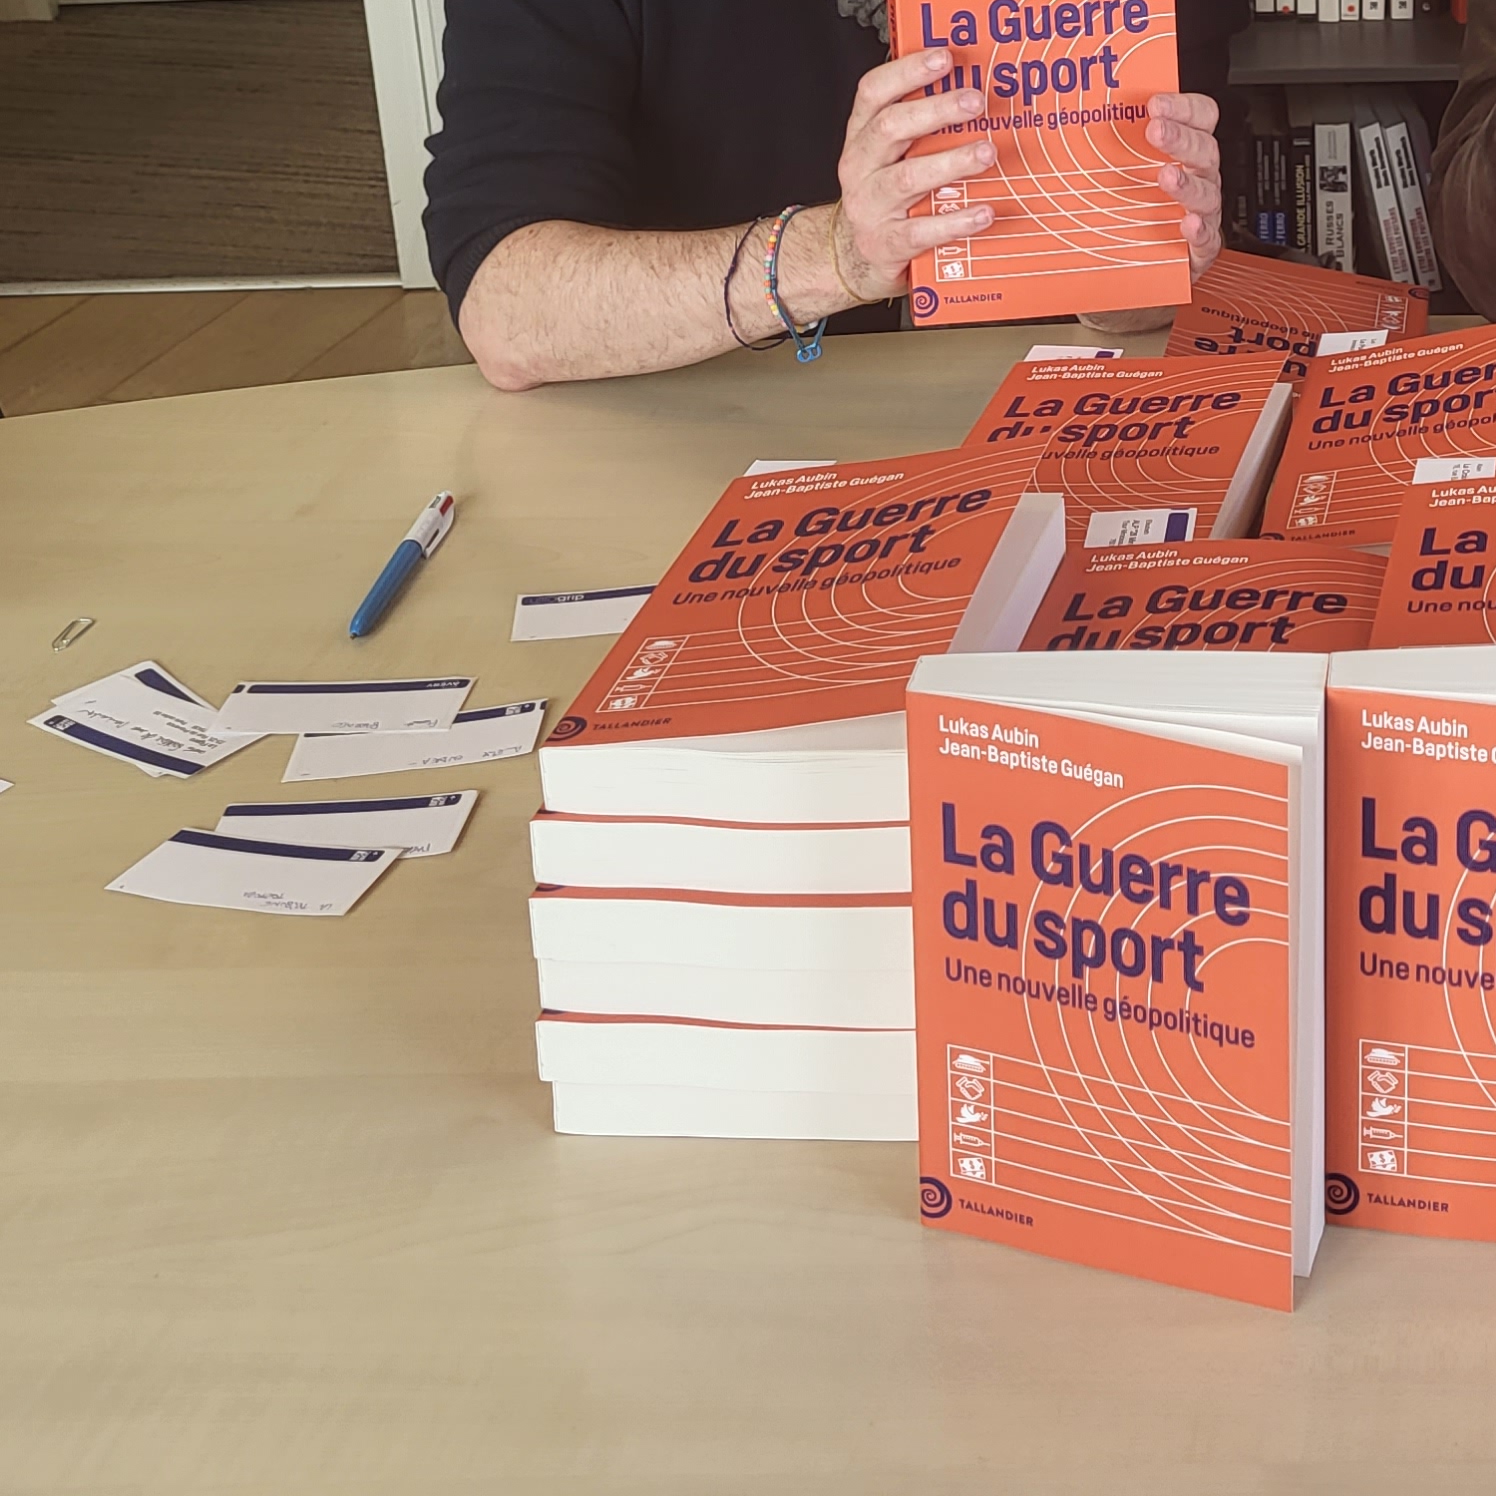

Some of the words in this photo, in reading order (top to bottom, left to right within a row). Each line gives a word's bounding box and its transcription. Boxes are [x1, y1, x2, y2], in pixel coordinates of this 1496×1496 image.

[920, 2, 977, 49] La
[994, 45, 1119, 105] sport
[967, 108, 1044, 133] nouvelle
[1048, 103, 1149, 130] géopolitiqu
[943, 292, 1002, 305] TALLANDIER
[711, 517, 785, 548] La
[794, 488, 993, 538] Guerre
[688, 551, 762, 584] du
[772, 523, 936, 579] sport
[939, 715, 989, 741] Lukas
[991, 726, 1039, 749] Aubin
[1361, 709, 1414, 733] Lukas
[1417, 715, 1468, 738] Aubin
[940, 741, 1058, 774] Jean-Baptiste
[1061, 758, 1124, 789] Guégan
[1361, 733, 1487, 765] Jean-Baptiste
[1360, 797, 1439, 867] La
[941, 801, 1014, 875] La
[1030, 820, 1251, 927] Guerre
[1358, 873, 1439, 941] du
[942, 879, 1019, 950] du
[1034, 908, 1205, 993] sport
[1360, 951, 1410, 980] Une
[945, 956, 992, 989] Une
[998, 974, 1098, 1014] nouvelle
[1103, 995, 1255, 1049] géopolitique
[959, 1198, 1034, 1227] TALLANDIER
[1367, 1192, 1449, 1214] TALLANDIER
